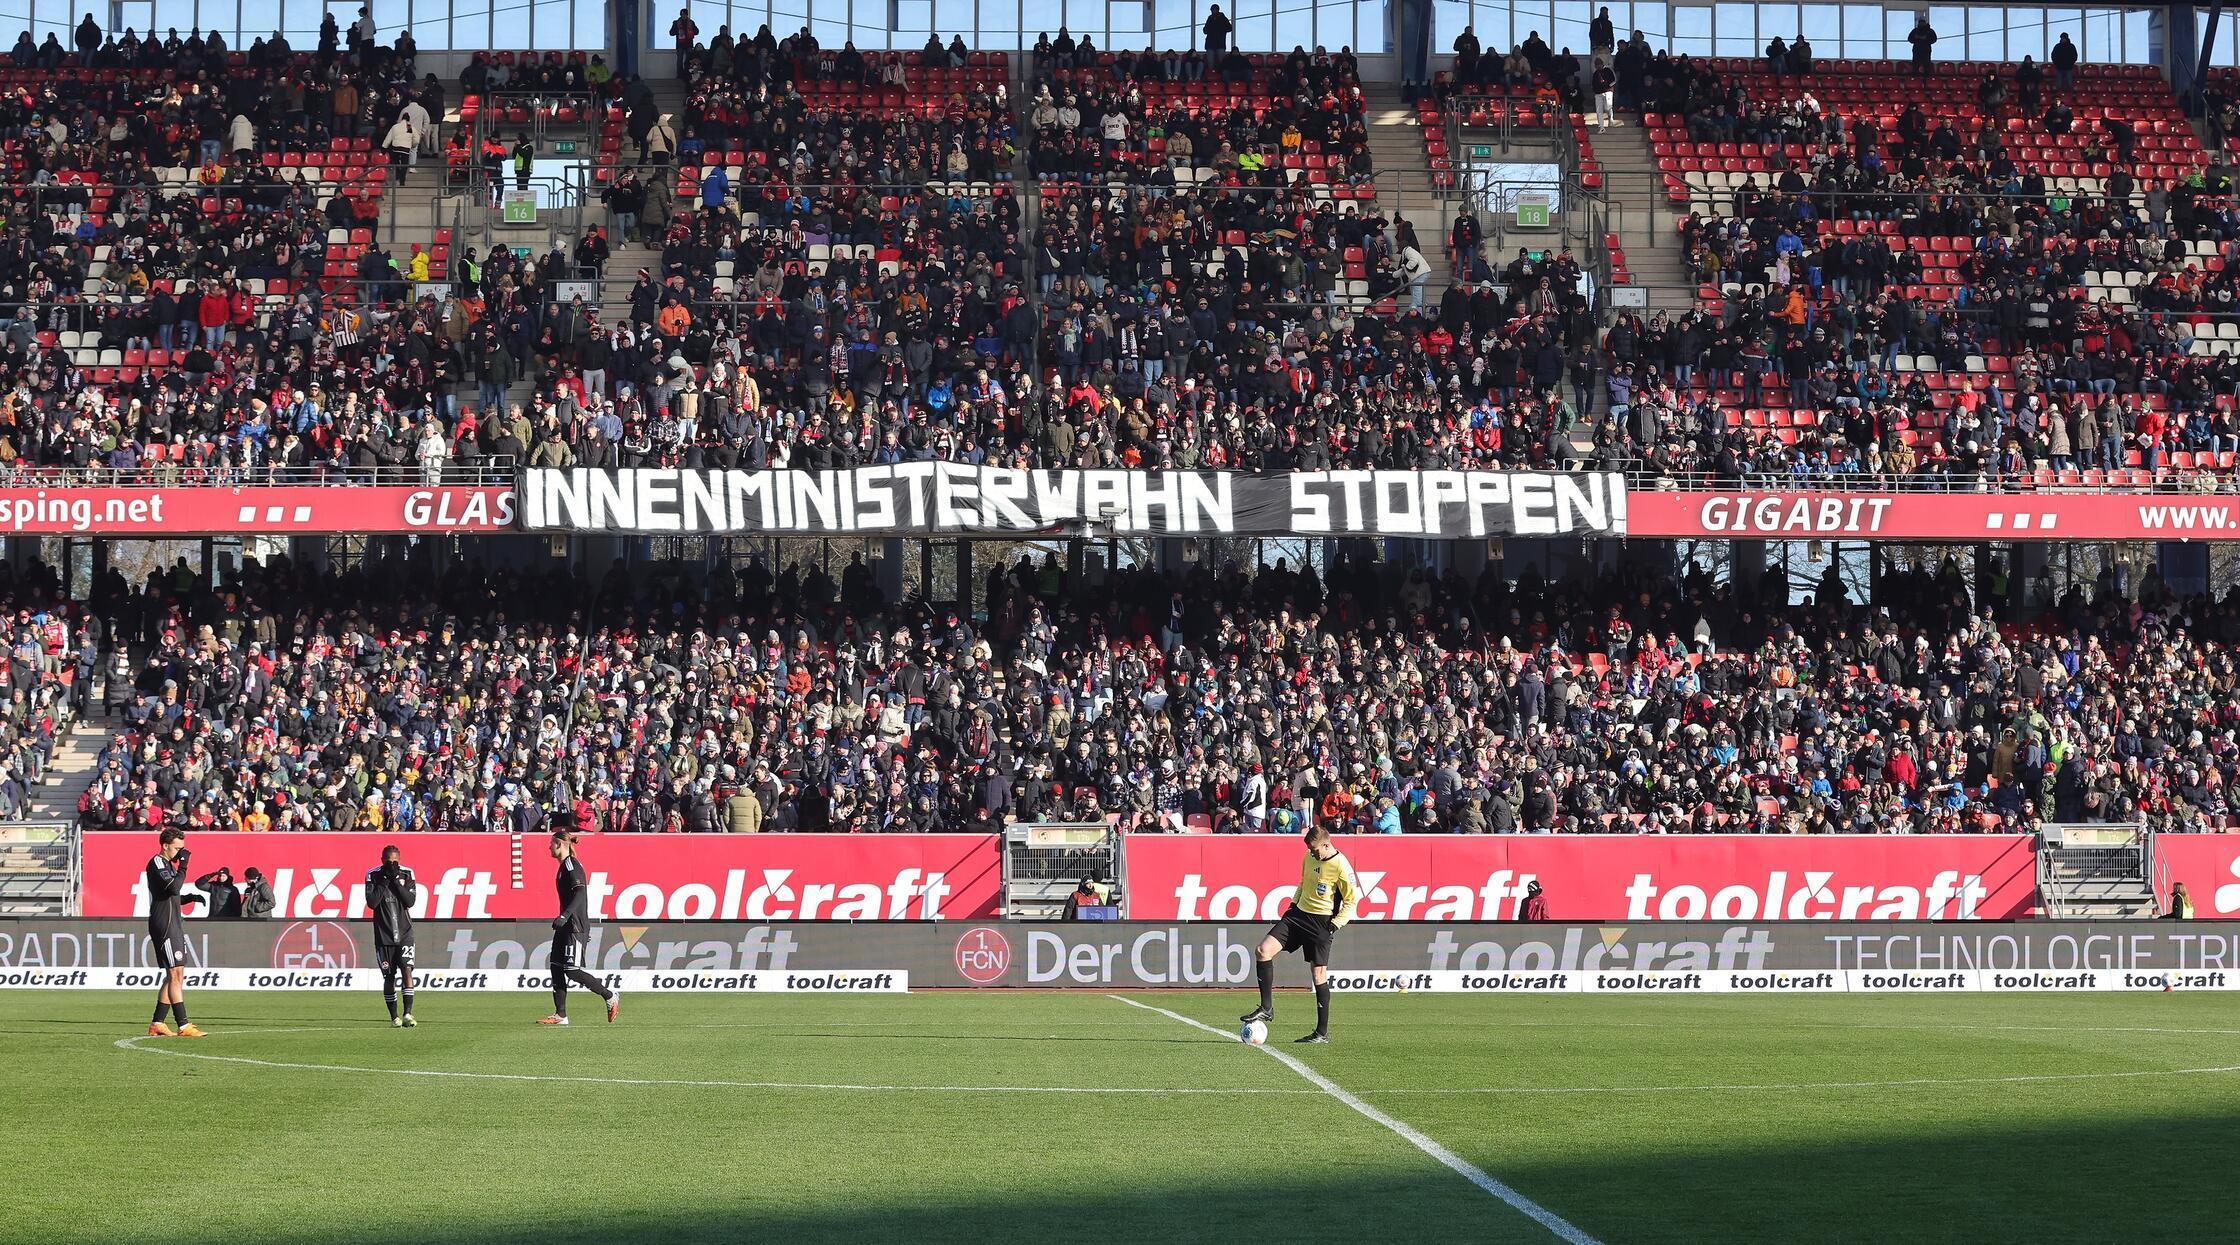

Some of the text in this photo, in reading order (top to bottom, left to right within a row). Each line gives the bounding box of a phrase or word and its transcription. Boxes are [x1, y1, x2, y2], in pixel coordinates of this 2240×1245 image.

[513, 208, 528, 219] 16
[1526, 211, 1541, 223] 18
[526, 462, 1628, 536] INNENMINISTERWAHN STOPPEN!
[1700, 496, 1892, 532] GIGABIT
[2138, 506, 2237, 529] www.
[1174, 870, 1537, 920] toocraft
[1625, 871, 1987, 919] toolcraft
[975, 931, 988, 950] 1.
[1427, 926, 1775, 970] toolcraft
[401, 945, 415, 958] 23
[564, 945, 575, 957] 11
[1027, 928, 1250, 983] Der Club
[961, 950, 1003, 970] FCN
[116, 972, 219, 986] toolaft
[249, 972, 353, 987] toolcraft
[651, 974, 757, 989] toolcraft
[787, 974, 892, 989] toolcraft
[1462, 974, 1567, 989] toolcraft
[1597, 974, 1701, 989] toolcraft
[1731, 974, 1832, 988] toolcraft
[1863, 974, 1965, 988] toolcraft
[1994, 973, 2096, 988] toolcraft
